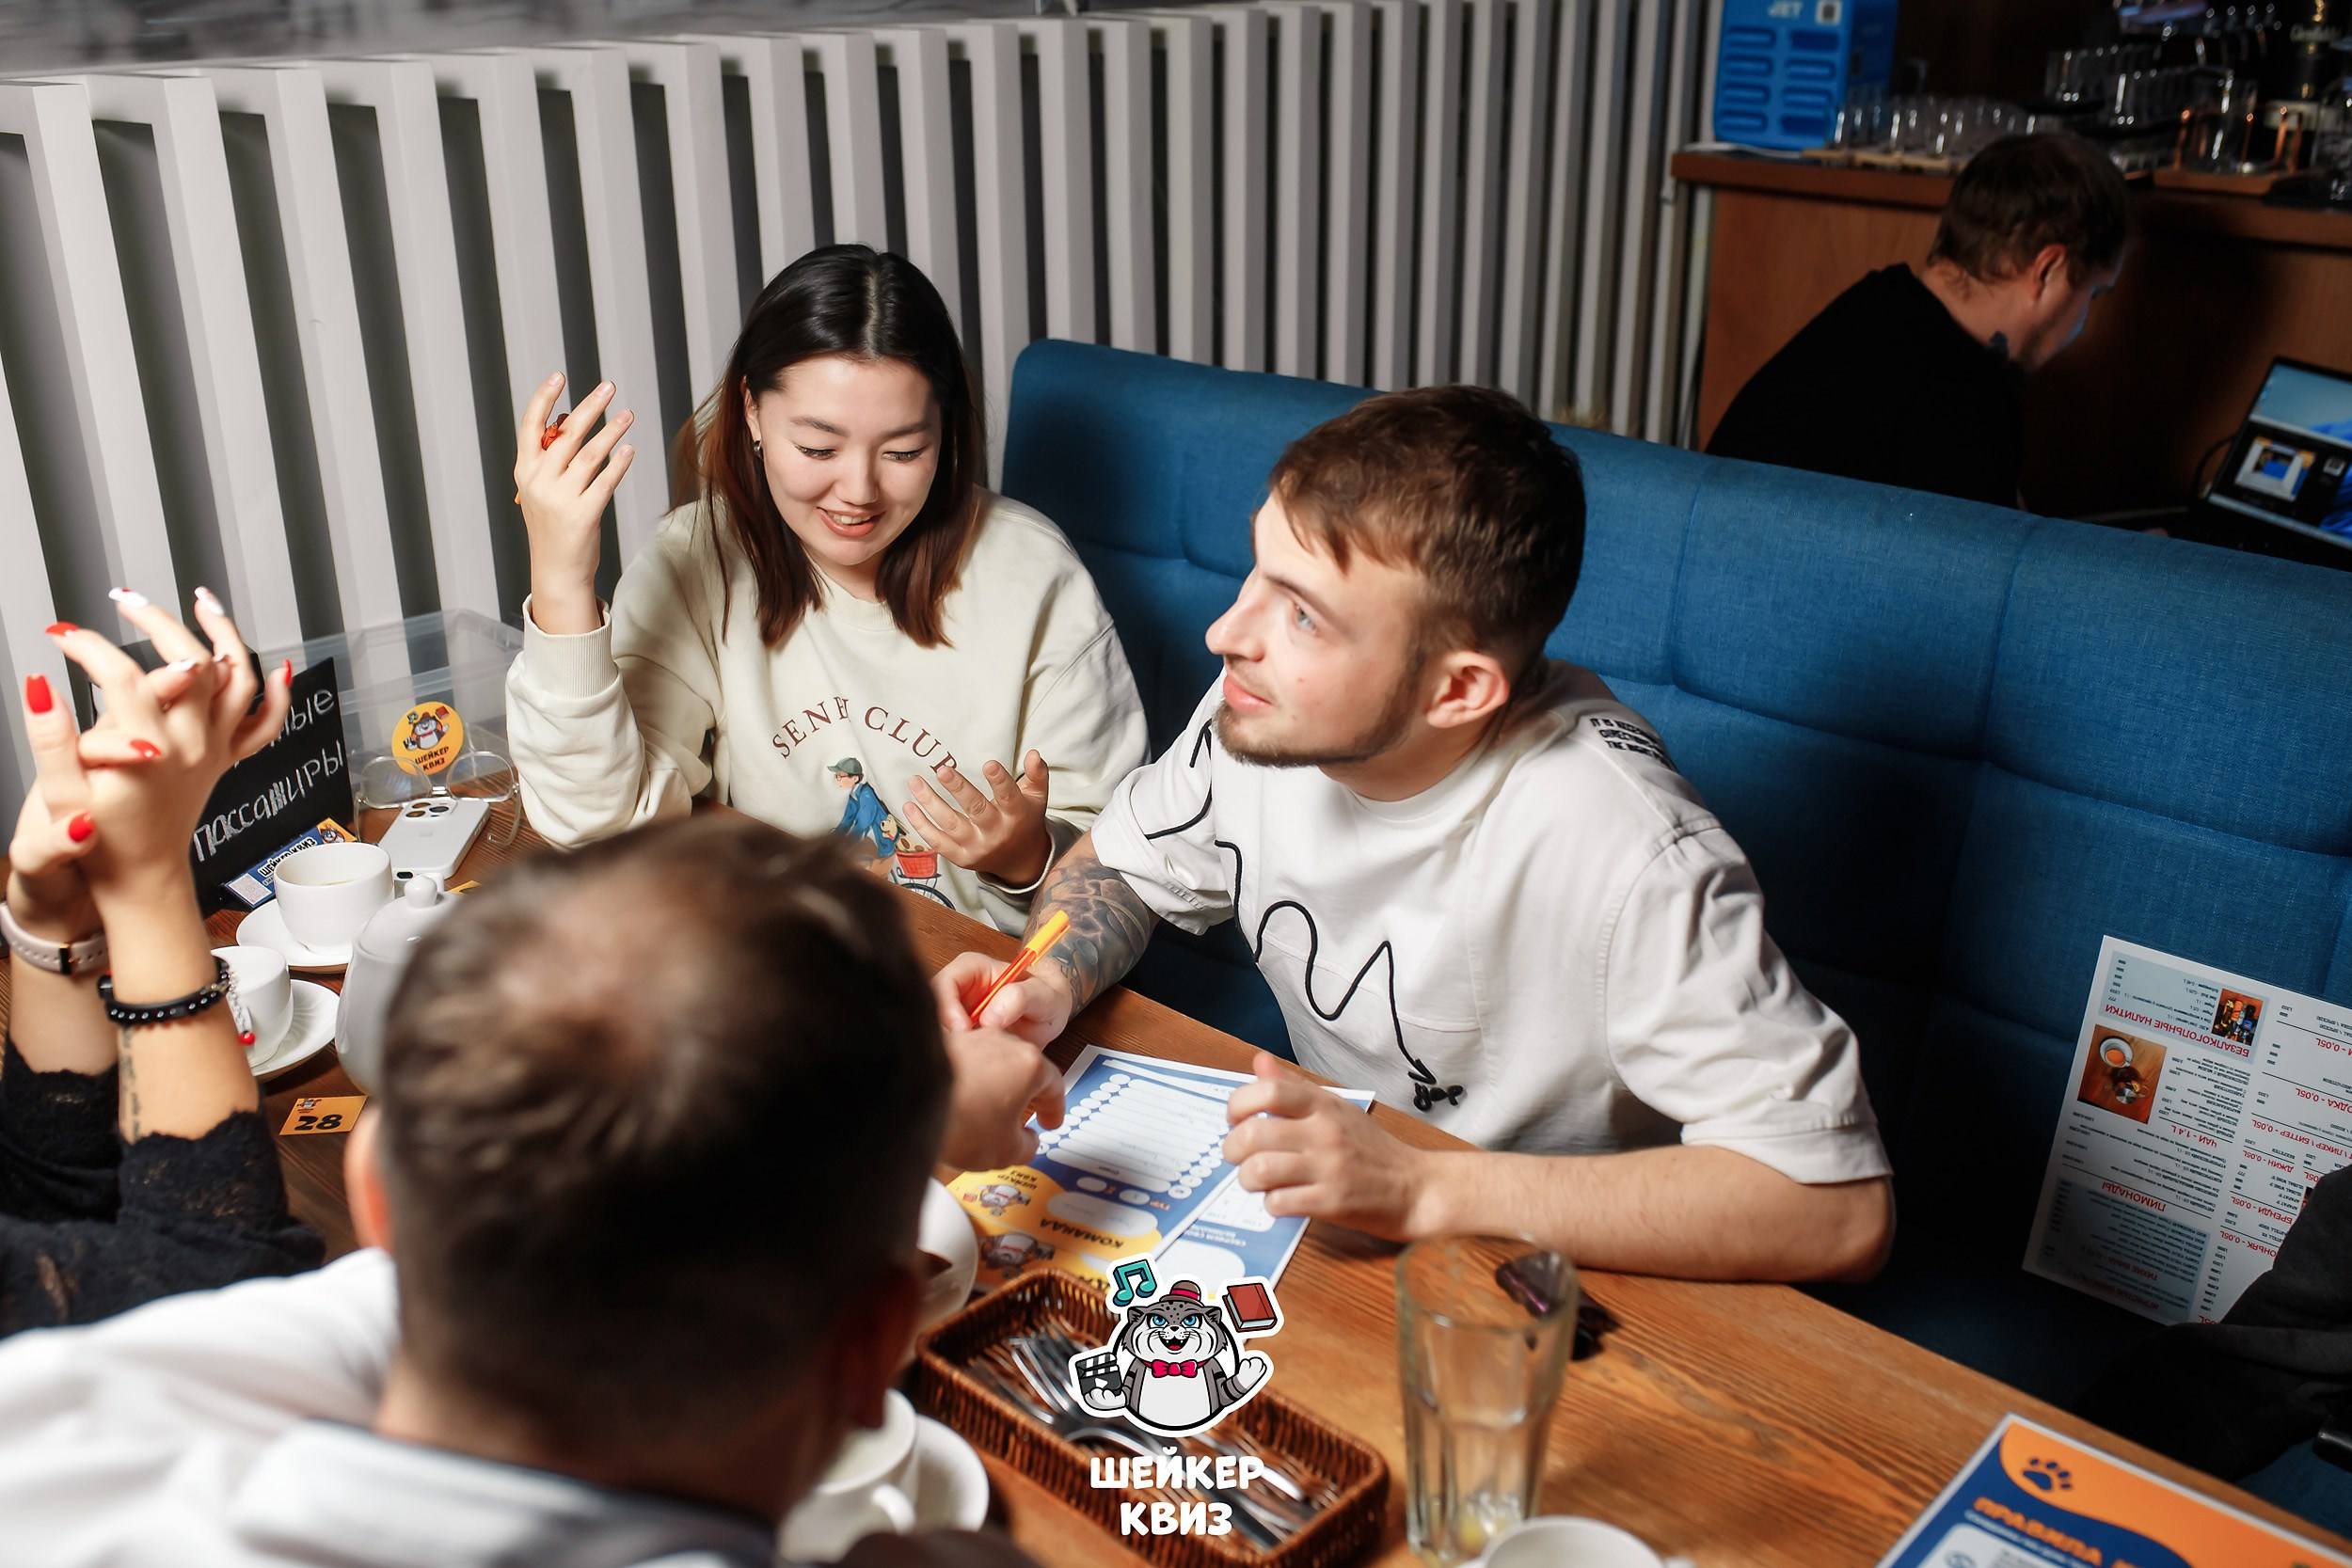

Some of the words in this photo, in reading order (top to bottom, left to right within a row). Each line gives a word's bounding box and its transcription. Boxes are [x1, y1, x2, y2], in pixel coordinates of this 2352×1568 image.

[415, 746, 450, 765] ШЕЙКЕР
[422, 757, 445, 771] КВИЗ
[2105, 1004, 2153, 1026] НАПИТКИ
[2153, 1020, 2250, 1057] БЕЗАЛКОГОЛЬНЫЕ
[294, 1114, 343, 1132] 28
[2280, 1129, 2310, 1145] БИТТЕР
[2315, 1142, 2344, 1156] ЛИКЕР
[2267, 1159, 2294, 1173] ДЖИН
[2101, 1181, 2167, 1212] ЛИМОНАДЫ
[2257, 1206, 2293, 1225] БРЕНДИ
[1040, 1217, 1124, 1249] КОМАНДА
[2246, 1241, 2278, 1258] ОНЬЯК
